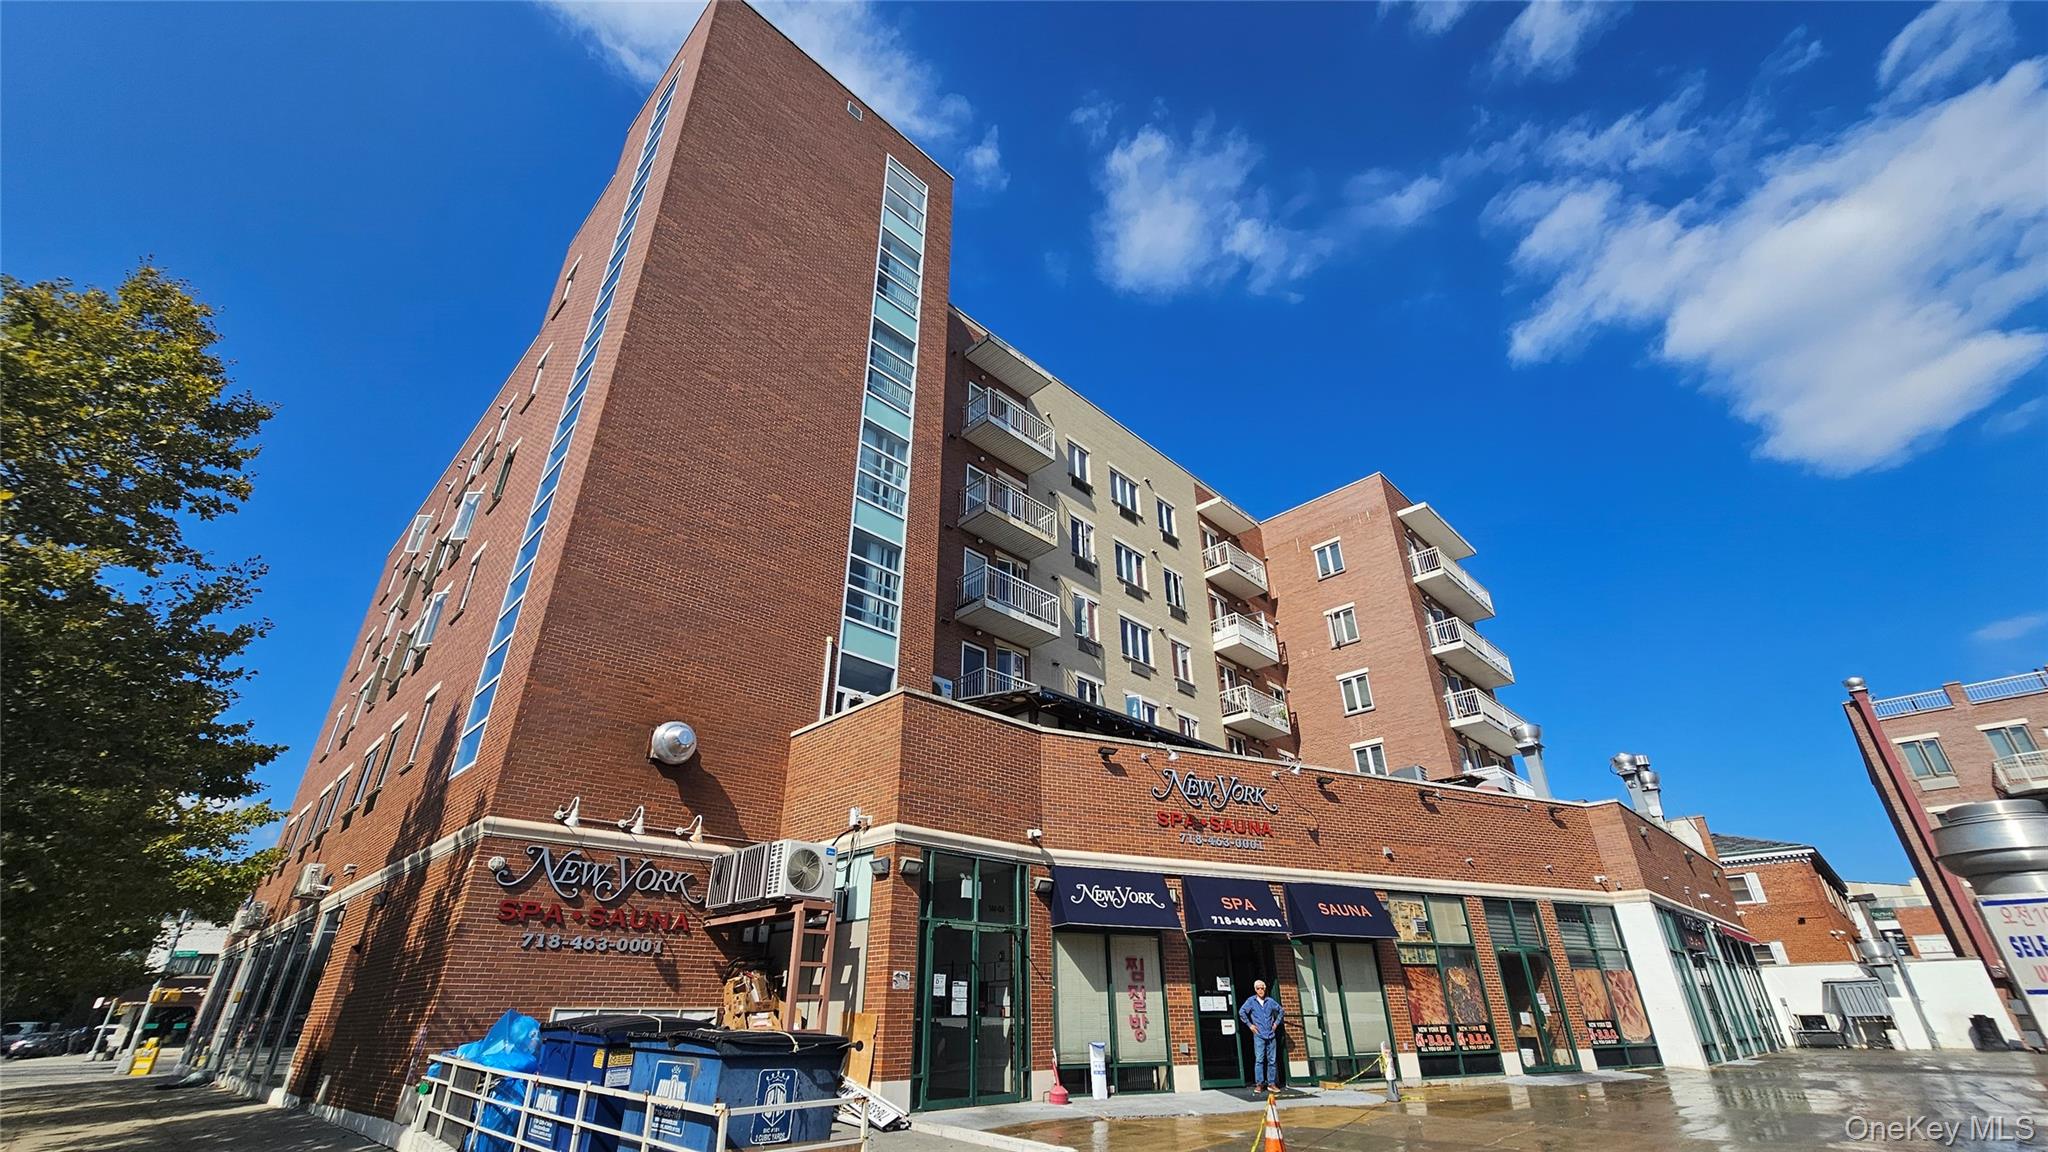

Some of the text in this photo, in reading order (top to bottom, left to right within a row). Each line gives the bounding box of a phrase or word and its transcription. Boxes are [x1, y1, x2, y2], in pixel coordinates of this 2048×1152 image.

[1209, 816, 1274, 837] SAUNA
[1180, 833, 1264, 849] 718-463-0001
[1221, 896, 1257, 911] SPA
[1318, 902, 1373, 918] SAUNA
[587, 907, 690, 932] SAUNA
[1211, 915, 1281, 928] 718-463-0001
[522, 933, 663, 954] 718-463-0001
[1125, 956, 1149, 1042] 찜질방
